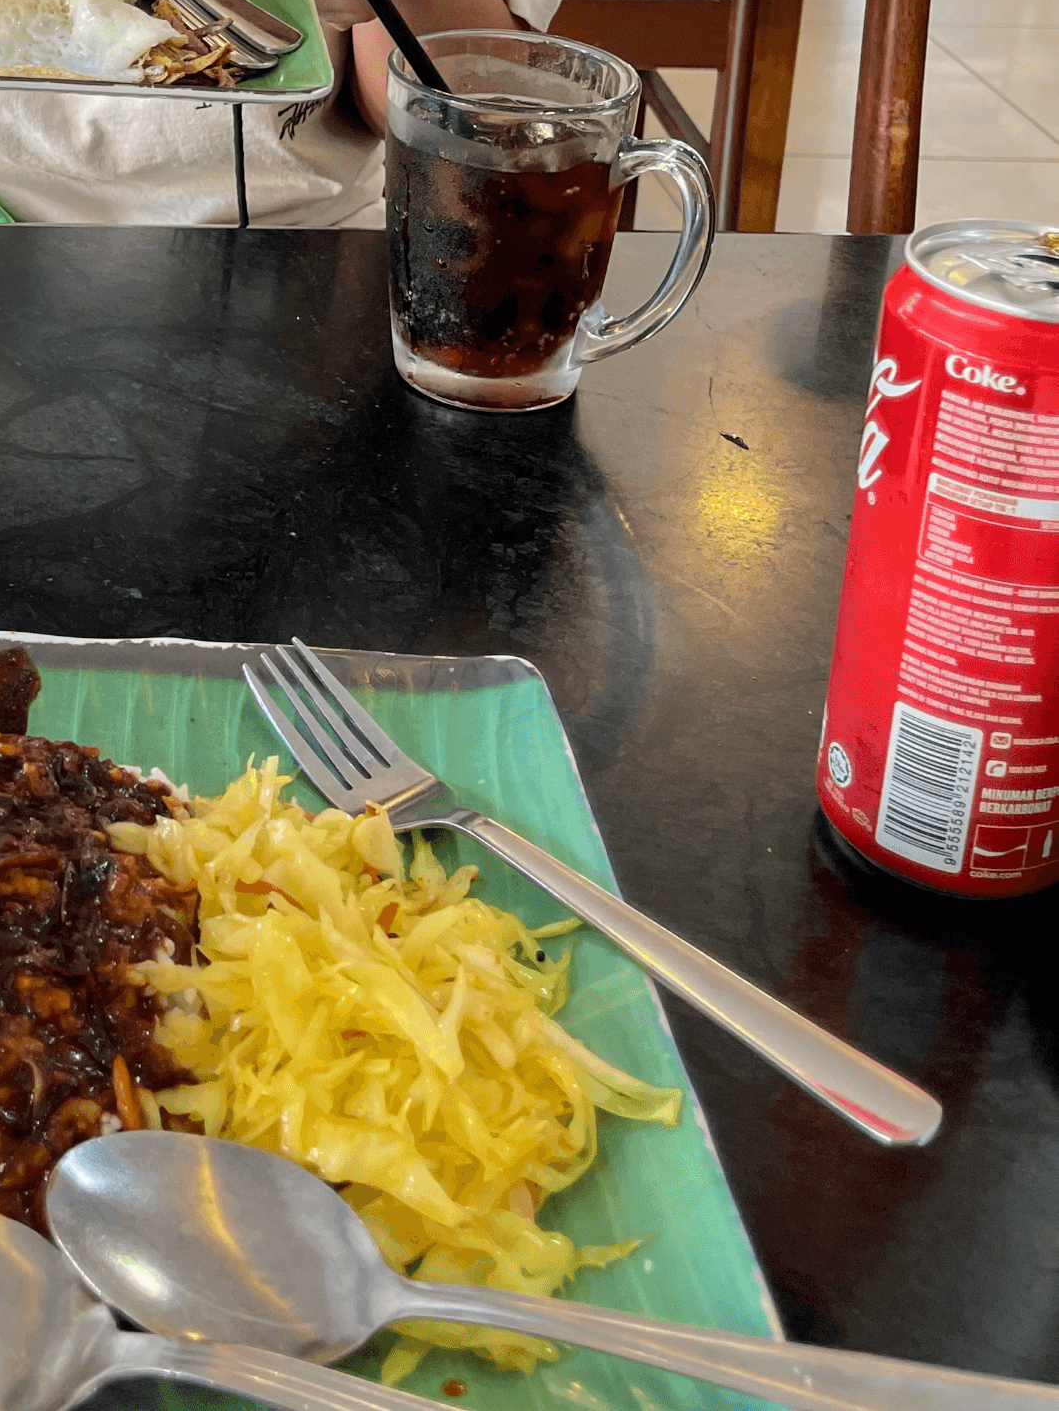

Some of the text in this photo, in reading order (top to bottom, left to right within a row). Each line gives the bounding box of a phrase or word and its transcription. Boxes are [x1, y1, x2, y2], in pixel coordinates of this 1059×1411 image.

[945, 354, 1017, 393] Coke
[982, 787, 1035, 802] MINUMAN
[979, 800, 1053, 815] BERKARBONAT
[969, 871, 1022, 879] coke.com
